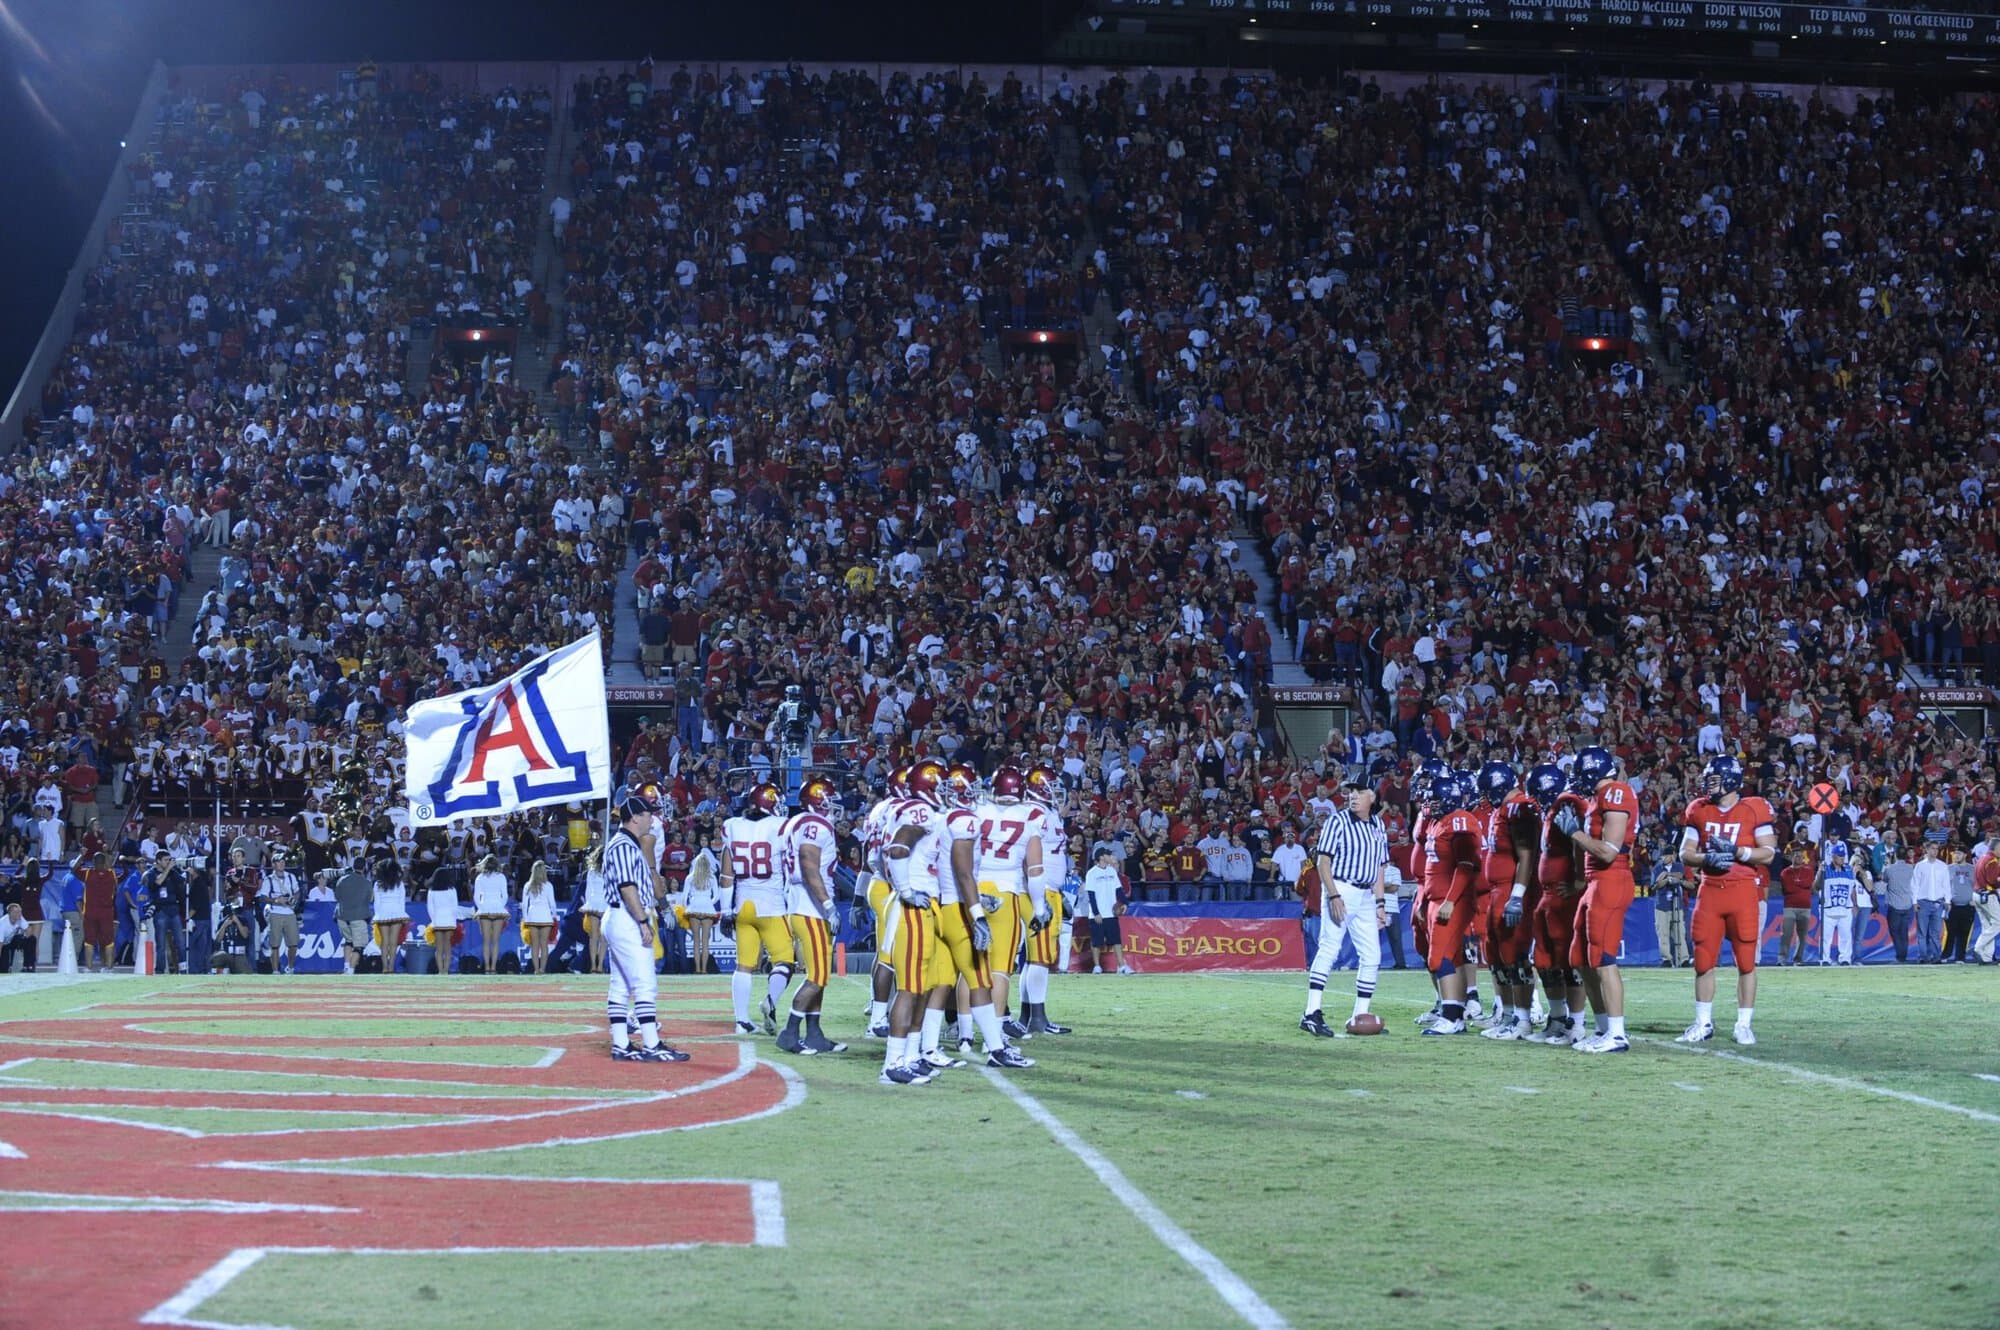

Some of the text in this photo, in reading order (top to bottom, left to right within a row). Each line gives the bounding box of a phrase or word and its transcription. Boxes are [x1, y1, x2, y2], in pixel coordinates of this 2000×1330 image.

[1601, 0, 1693, 14] HAROLD McCLELLAN
[1705, 4, 1781, 18] EDDIE WILSON
[1565, 13, 1588, 22] 1985
[1608, 15, 1686, 27] 1920 1922
[1809, 9, 1867, 23] TED BLAND
[1888, 13, 1974, 29] TOM GREENFIELD
[1704, 20, 1781, 31] 1959 1961
[1800, 25, 1875, 37] 1933 1935
[1893, 30, 1968, 42] 1936 1938
[965, 439, 972, 449] 3
[149, 665, 161, 679] 19
[614, 691, 645, 700] SECTION
[647, 691, 655, 700] 18
[1283, 692, 1333, 700] 18 SECTION 19
[1937, 692, 1965, 700] SECTION
[1966, 692, 1975, 700] 20
[1604, 787, 1623, 804] 48
[911, 808, 928, 825] 36
[258, 825, 268, 837] 17
[967, 820, 975, 834] 4
[1452, 817, 1467, 831] 61
[804, 825, 818, 840] 43
[731, 841, 772, 879] 58
[1182, 856, 1193, 870] 11
[1832, 897, 1847, 906] 10
[1175, 936, 1281, 956] FARGO
